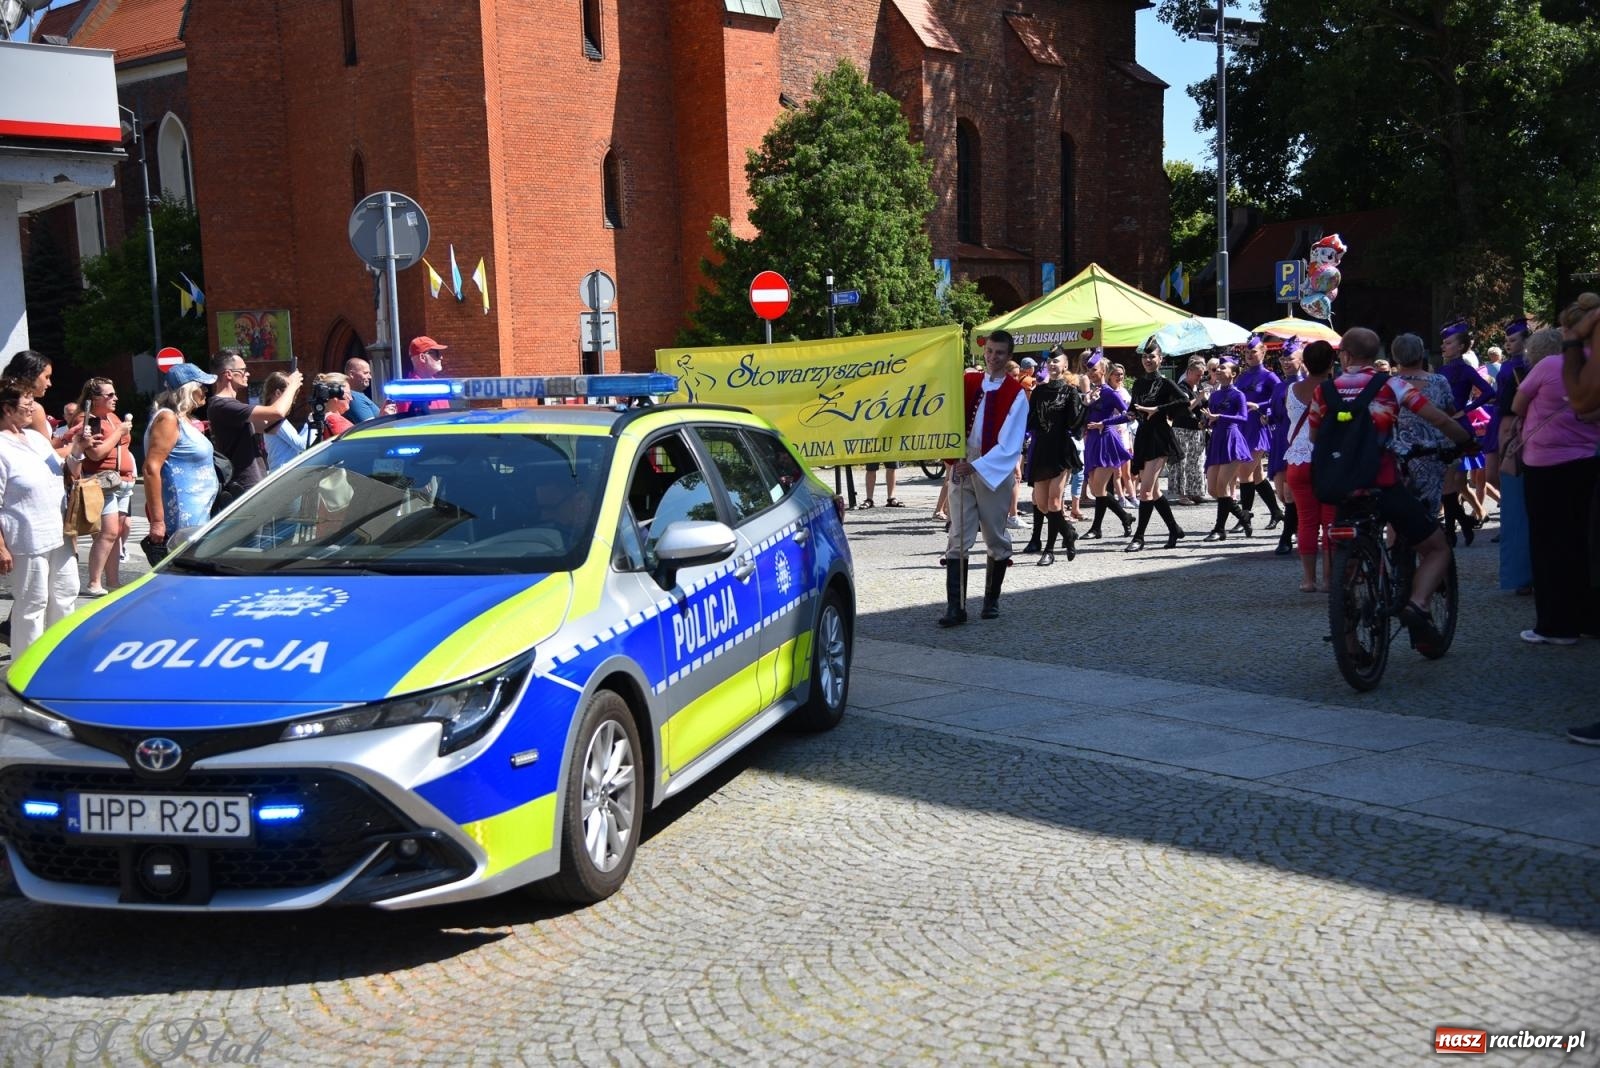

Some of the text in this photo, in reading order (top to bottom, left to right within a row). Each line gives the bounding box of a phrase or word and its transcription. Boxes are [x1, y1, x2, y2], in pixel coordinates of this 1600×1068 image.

[1282, 264, 1294, 281] P
[1026, 331, 1078, 344] TRUSKAWKI
[472, 378, 545, 397] POLICJA
[727, 353, 907, 389] Stowarzyszenie
[797, 384, 945, 428] Źródło
[843, 437, 893, 455] WIELU
[900, 433, 961, 451] KULTUR
[672, 585, 739, 660] POLICJA
[94, 638, 330, 673] POLICJA
[86, 799, 241, 832] HPP R205
